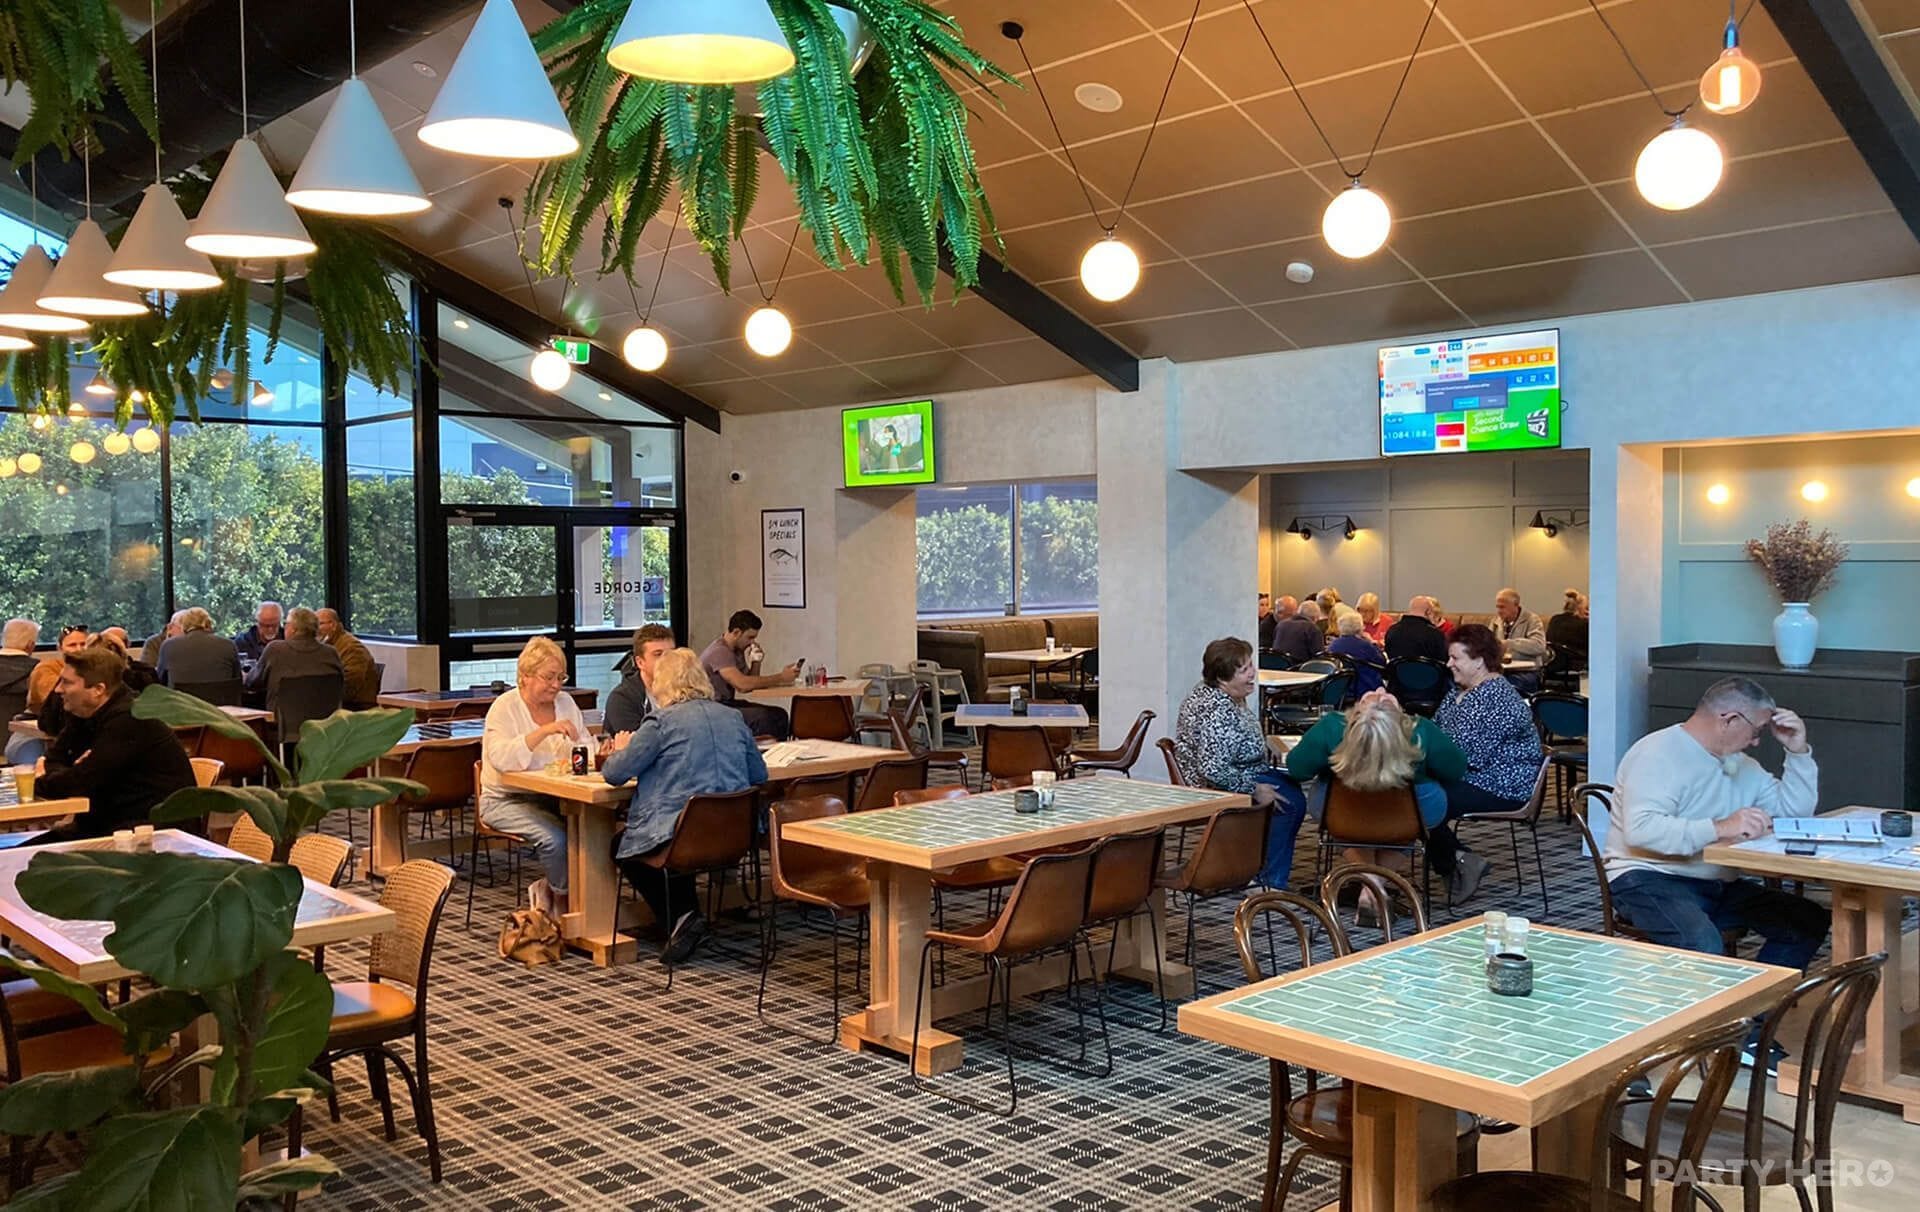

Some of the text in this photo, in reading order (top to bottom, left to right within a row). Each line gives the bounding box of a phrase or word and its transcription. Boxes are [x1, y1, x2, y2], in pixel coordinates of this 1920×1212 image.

[1471, 421, 1520, 434] Chance Draw
[769, 530, 796, 541] SPECIALS
